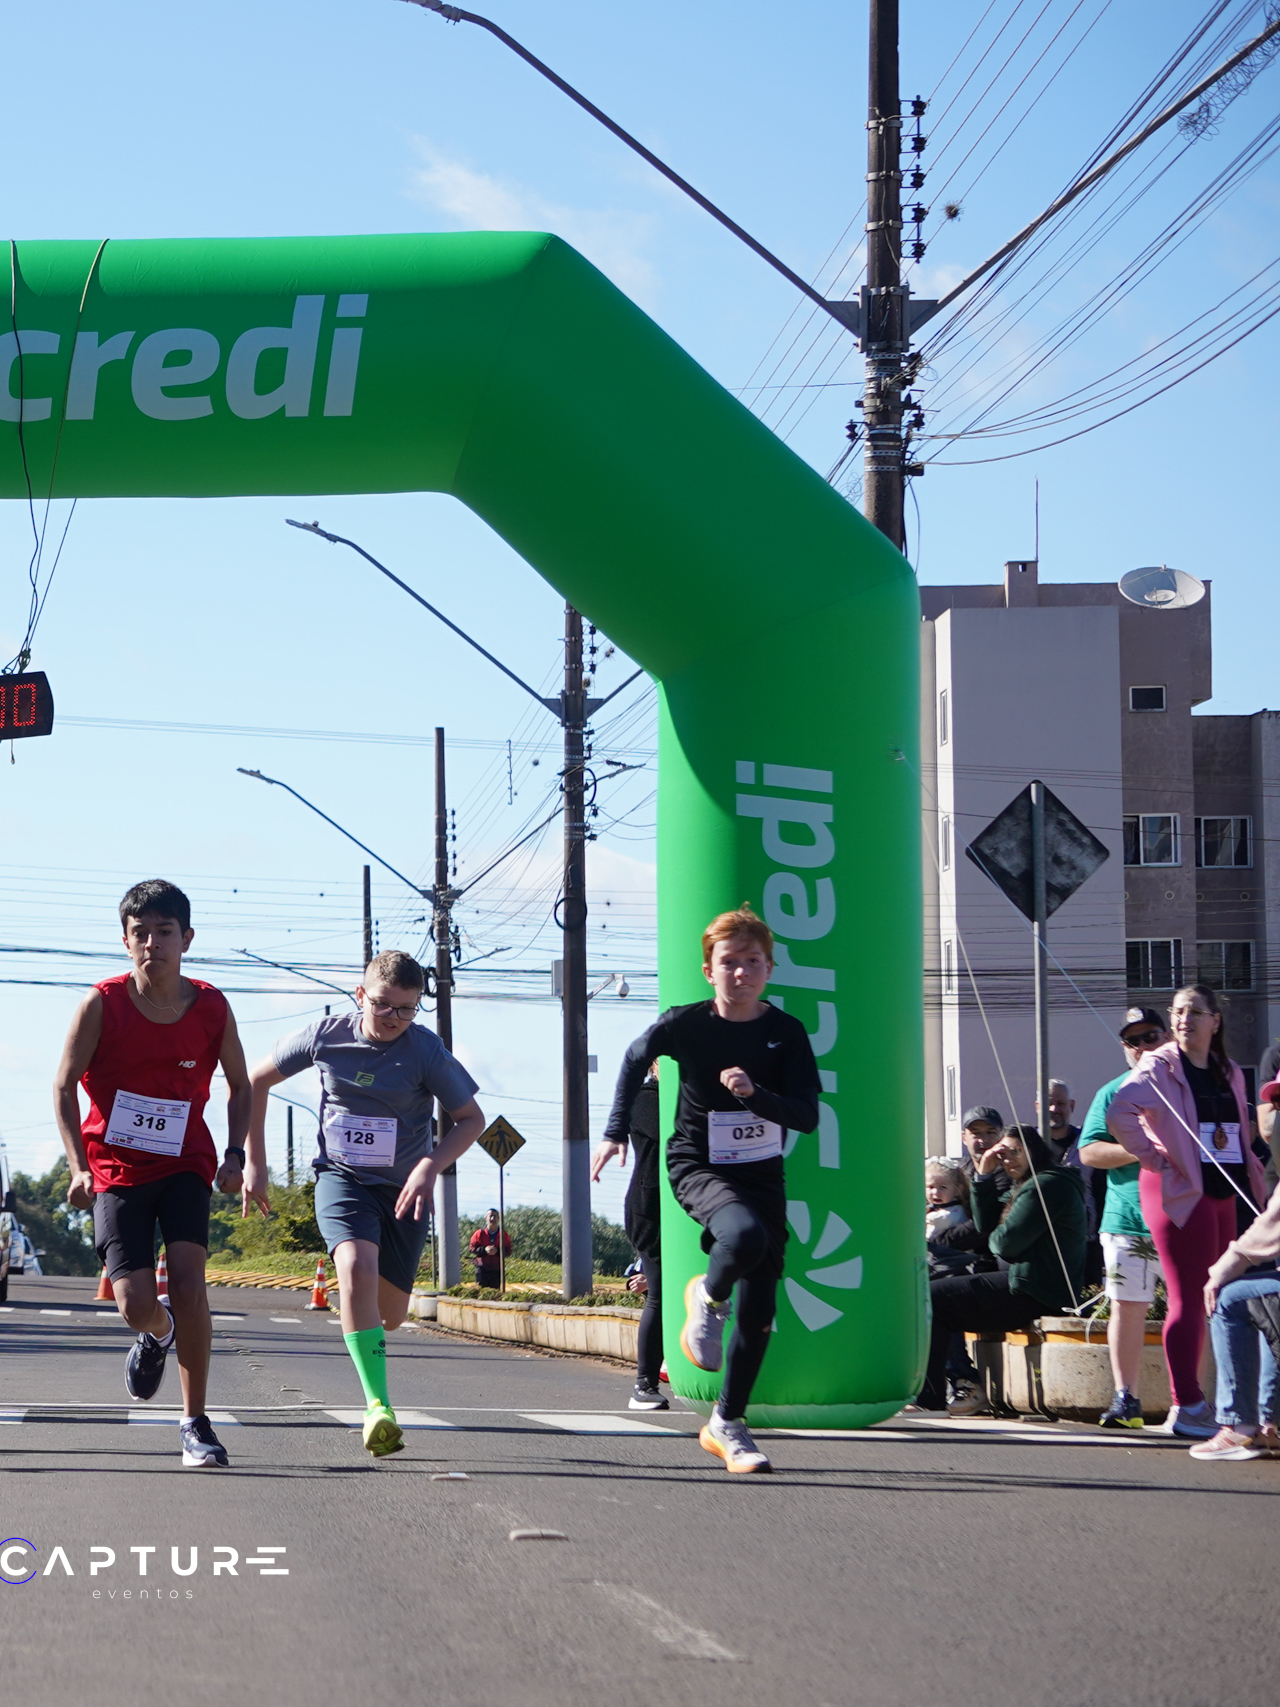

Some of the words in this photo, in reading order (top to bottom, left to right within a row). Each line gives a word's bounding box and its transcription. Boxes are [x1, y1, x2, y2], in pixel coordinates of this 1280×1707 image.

[133, 1114, 166, 1131] 318
[344, 1130, 375, 1145] 128
[732, 1125, 765, 1140] 023
